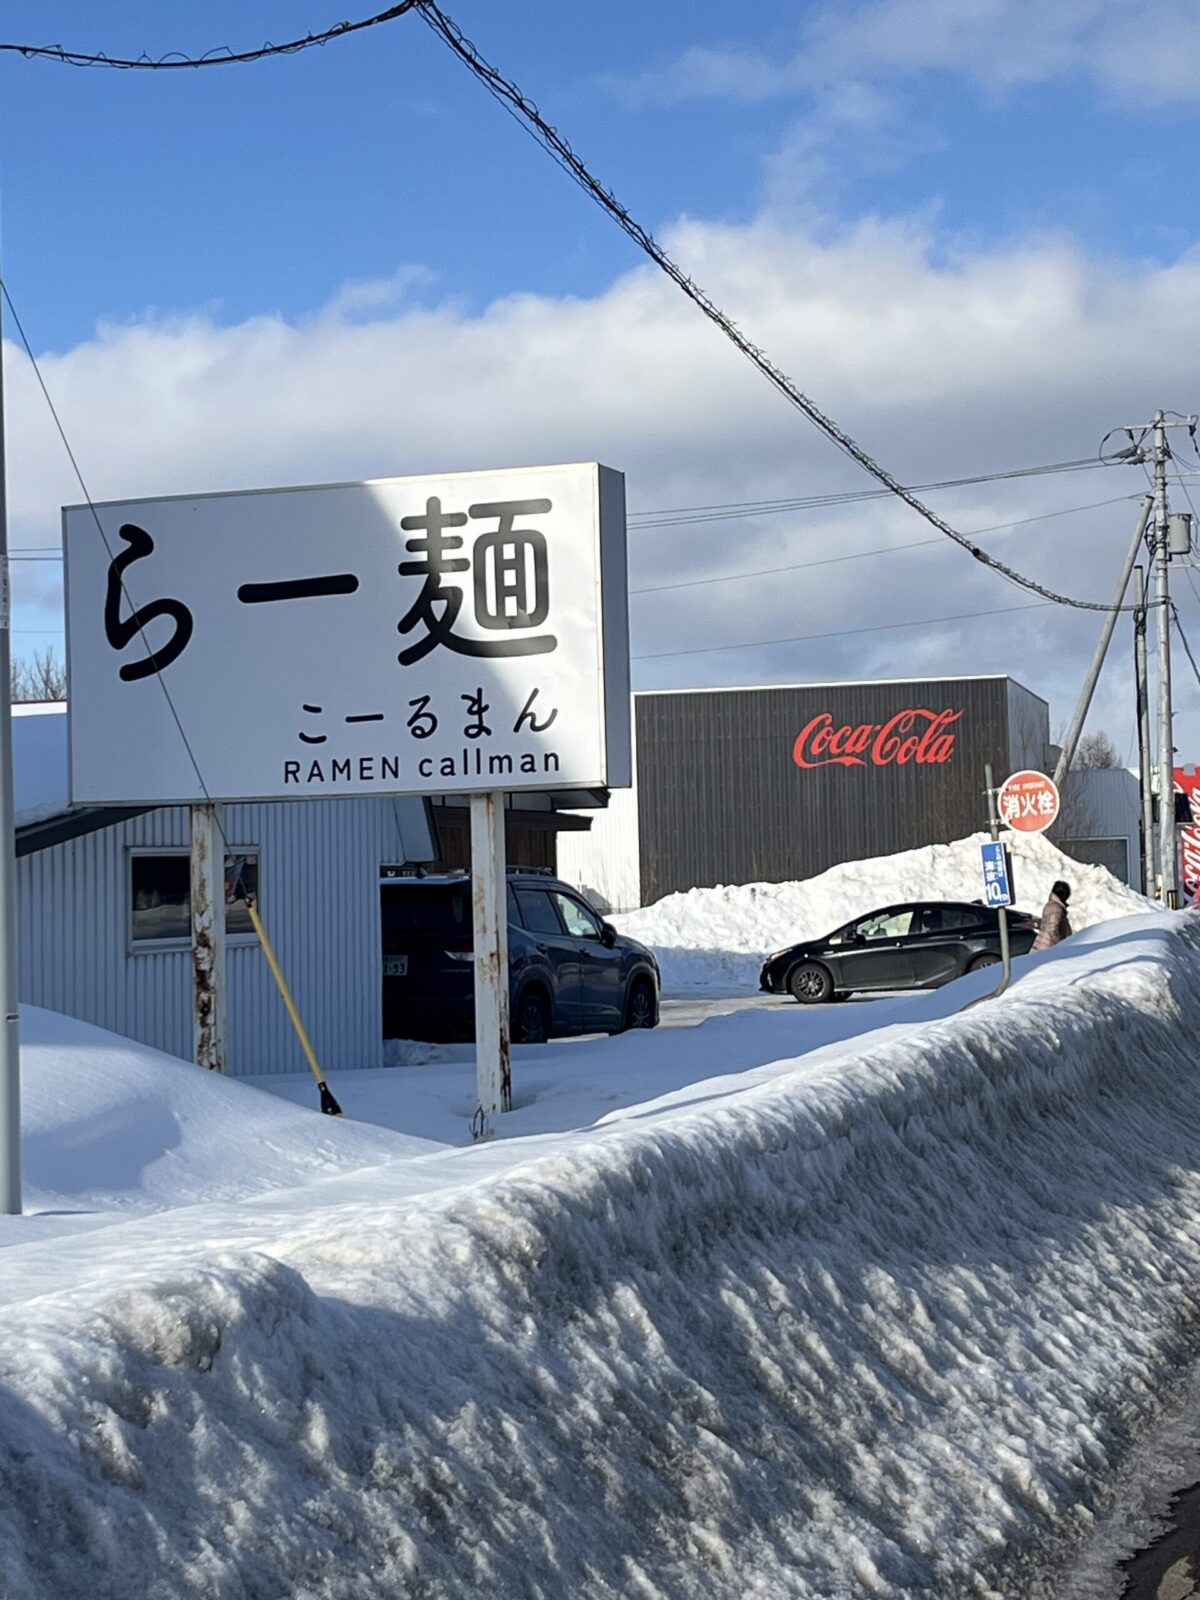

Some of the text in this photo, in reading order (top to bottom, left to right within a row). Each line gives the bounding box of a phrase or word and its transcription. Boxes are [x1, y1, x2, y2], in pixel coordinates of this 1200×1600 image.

[105, 496, 558, 682] らー麺
[298, 687, 558, 744] こーるまん
[793, 708, 965, 769] Coca-Cola
[284, 747, 560, 784] RAMEN callman
[1002, 790, 1054, 819] 消火栓
[985, 881, 1009, 902] 10m
